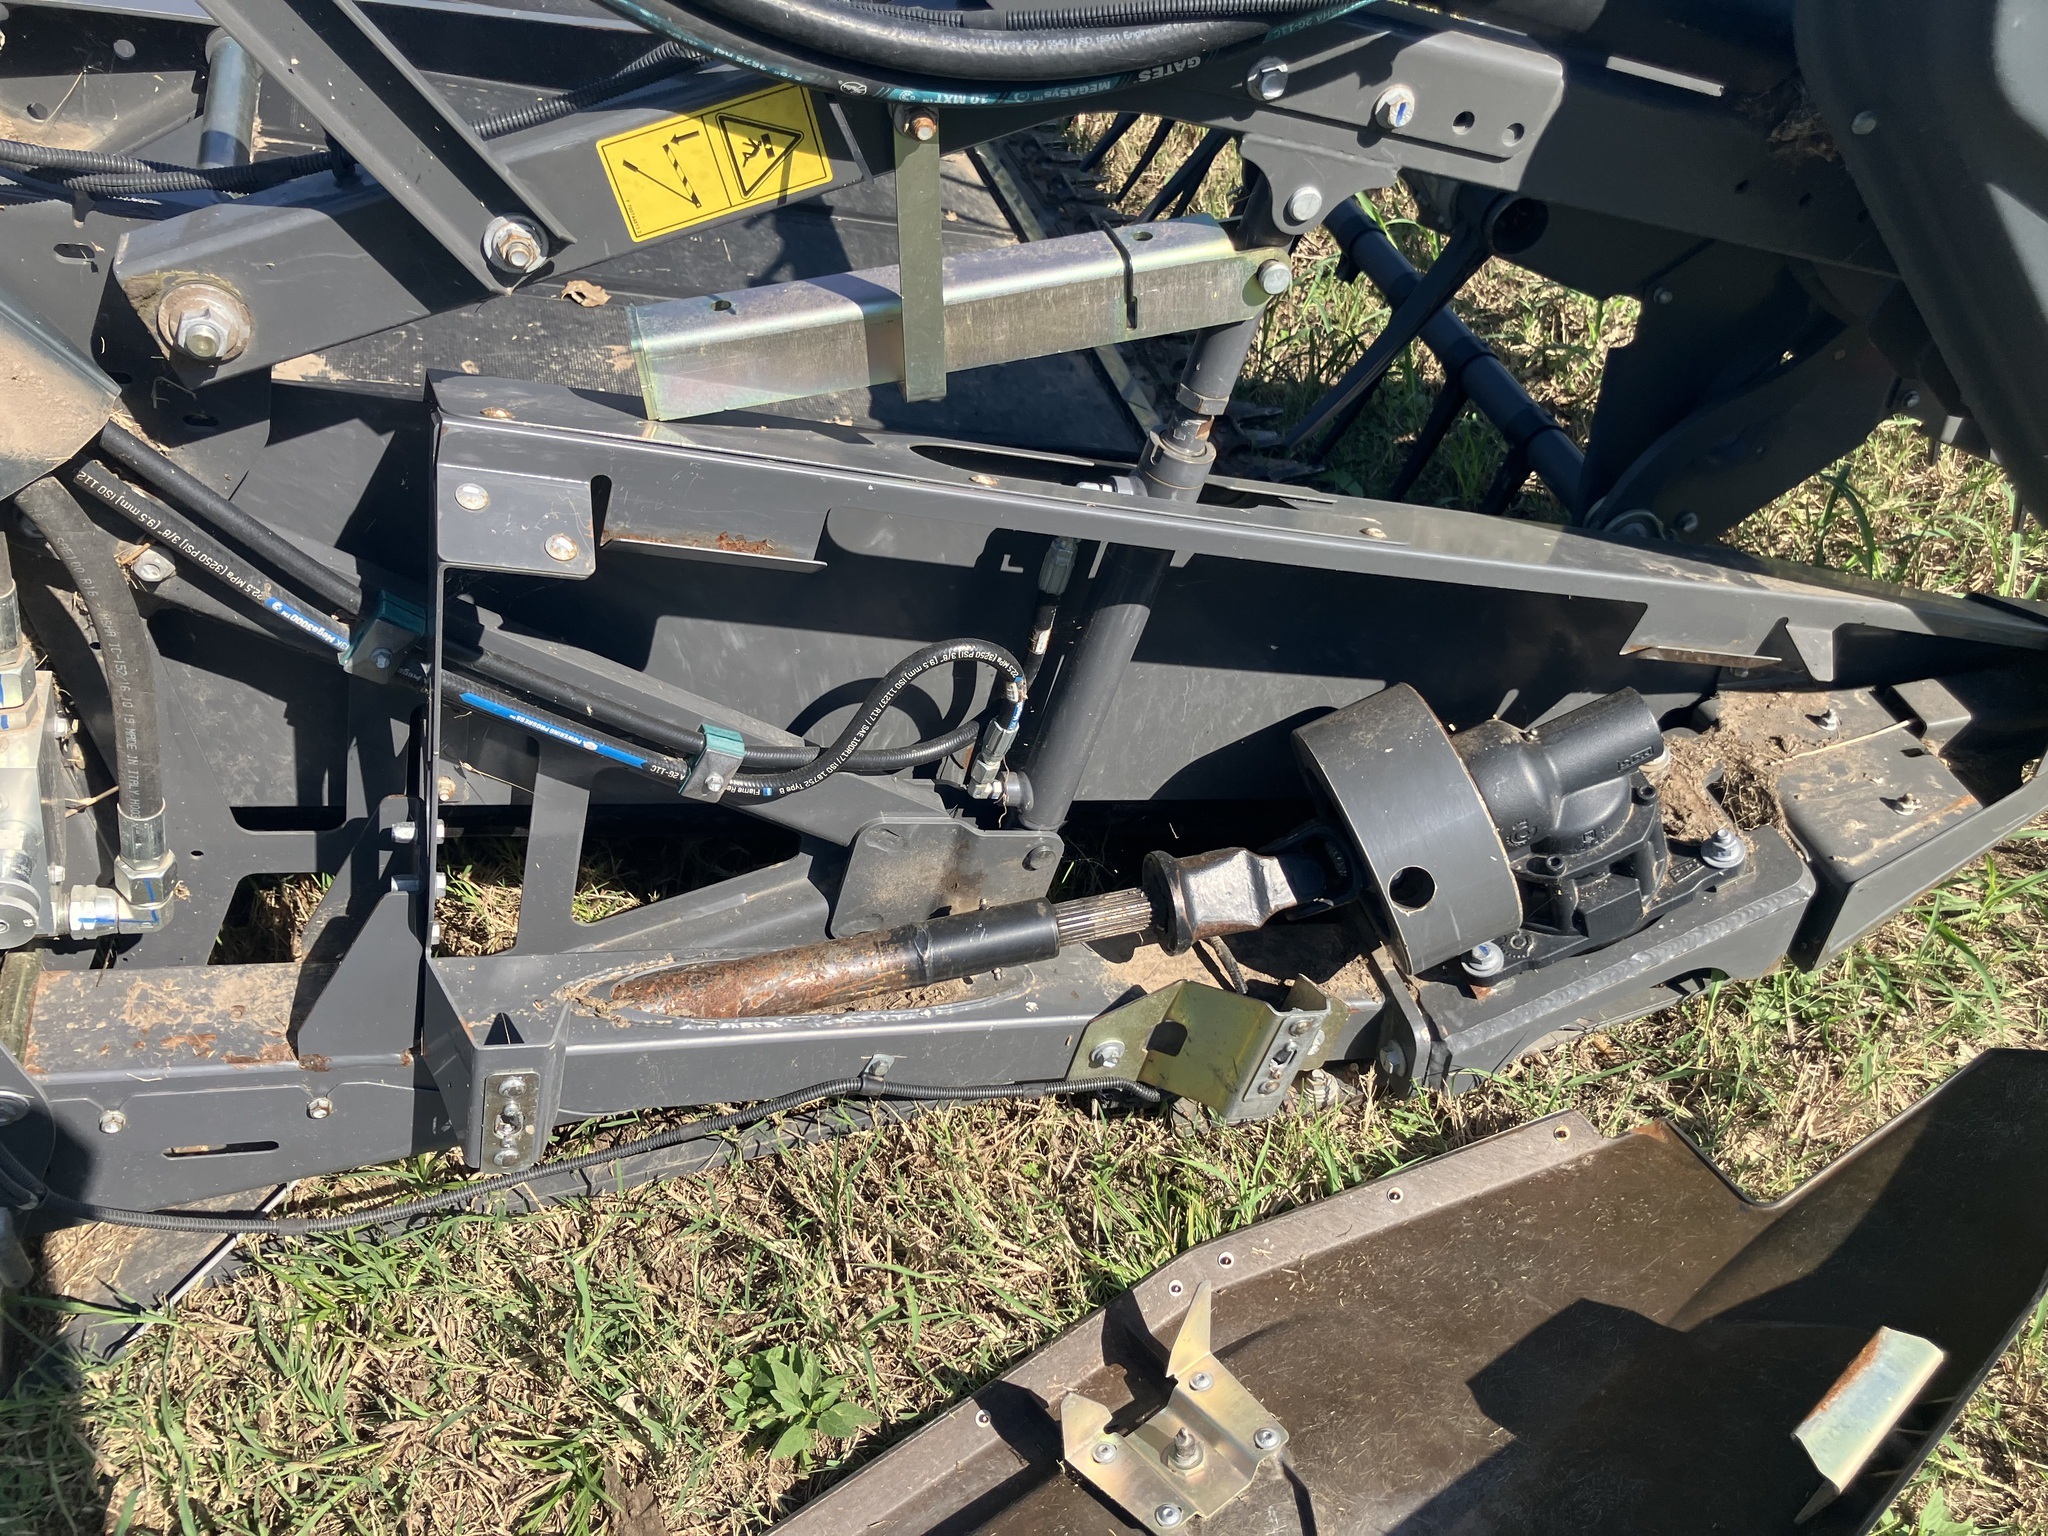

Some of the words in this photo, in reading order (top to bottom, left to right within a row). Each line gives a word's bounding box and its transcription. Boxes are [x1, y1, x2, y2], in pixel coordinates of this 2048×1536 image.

[1138, 56, 1201, 83] GATES
[97, 485, 116, 500] ISO
[115, 495, 140, 516] mm)
[139, 513, 162, 530] (9.5
[178, 539, 200, 558] PSI)
[198, 554, 229, 576] (3250
[82, 577, 100, 598] R16
[226, 572, 246, 588] MPa
[100, 611, 118, 639] MSHA
[922, 656, 938, 670] (9.5
[958, 651, 975, 659] PSI)
[974, 651, 998, 663] (3250
[996, 656, 1010, 670] MPa
[905, 664, 923, 680] mm)
[1006, 664, 1019, 679] 22.5
[895, 676, 908, 690] ISO
[879, 688, 898, 710] 11237
[871, 706, 882, 722] R17
[125, 726, 138, 752] MADE
[550, 727, 582, 745] POWERING
[856, 724, 870, 738] SAE
[126, 754, 138, 766] IN
[826, 761, 839, 774] ISO
[650, 764, 680, 780] 2G-11C
[804, 770, 828, 787] 18752
[128, 770, 141, 797] ITALY
[787, 783, 804, 794] Type
[737, 788, 761, 796] Flame
